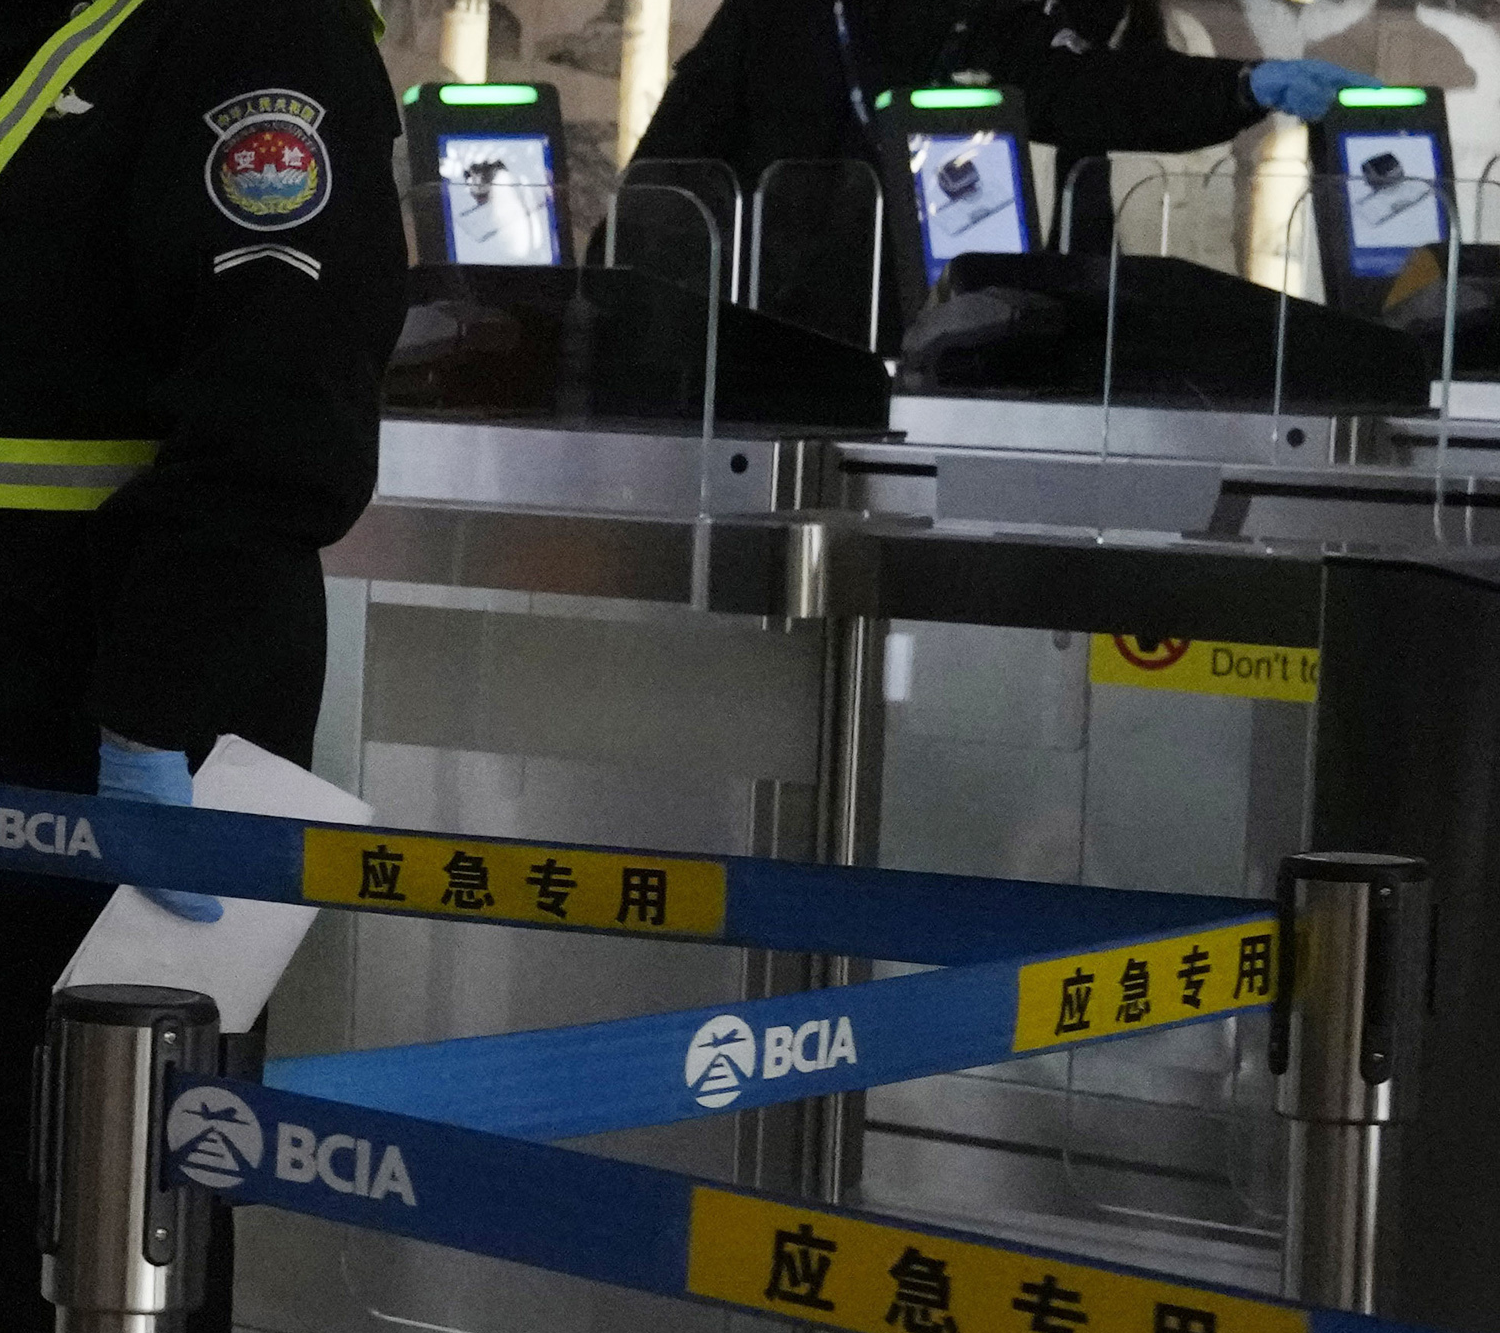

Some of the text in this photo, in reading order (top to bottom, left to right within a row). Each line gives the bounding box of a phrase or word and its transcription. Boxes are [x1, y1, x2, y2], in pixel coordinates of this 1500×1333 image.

[1211, 648, 1288, 682] Don't
[355, 843, 670, 928] 应急专用
[1055, 931, 1272, 1035] 应急专用
[762, 1016, 858, 1080] BCIA
[274, 1121, 418, 1207] BCIA
